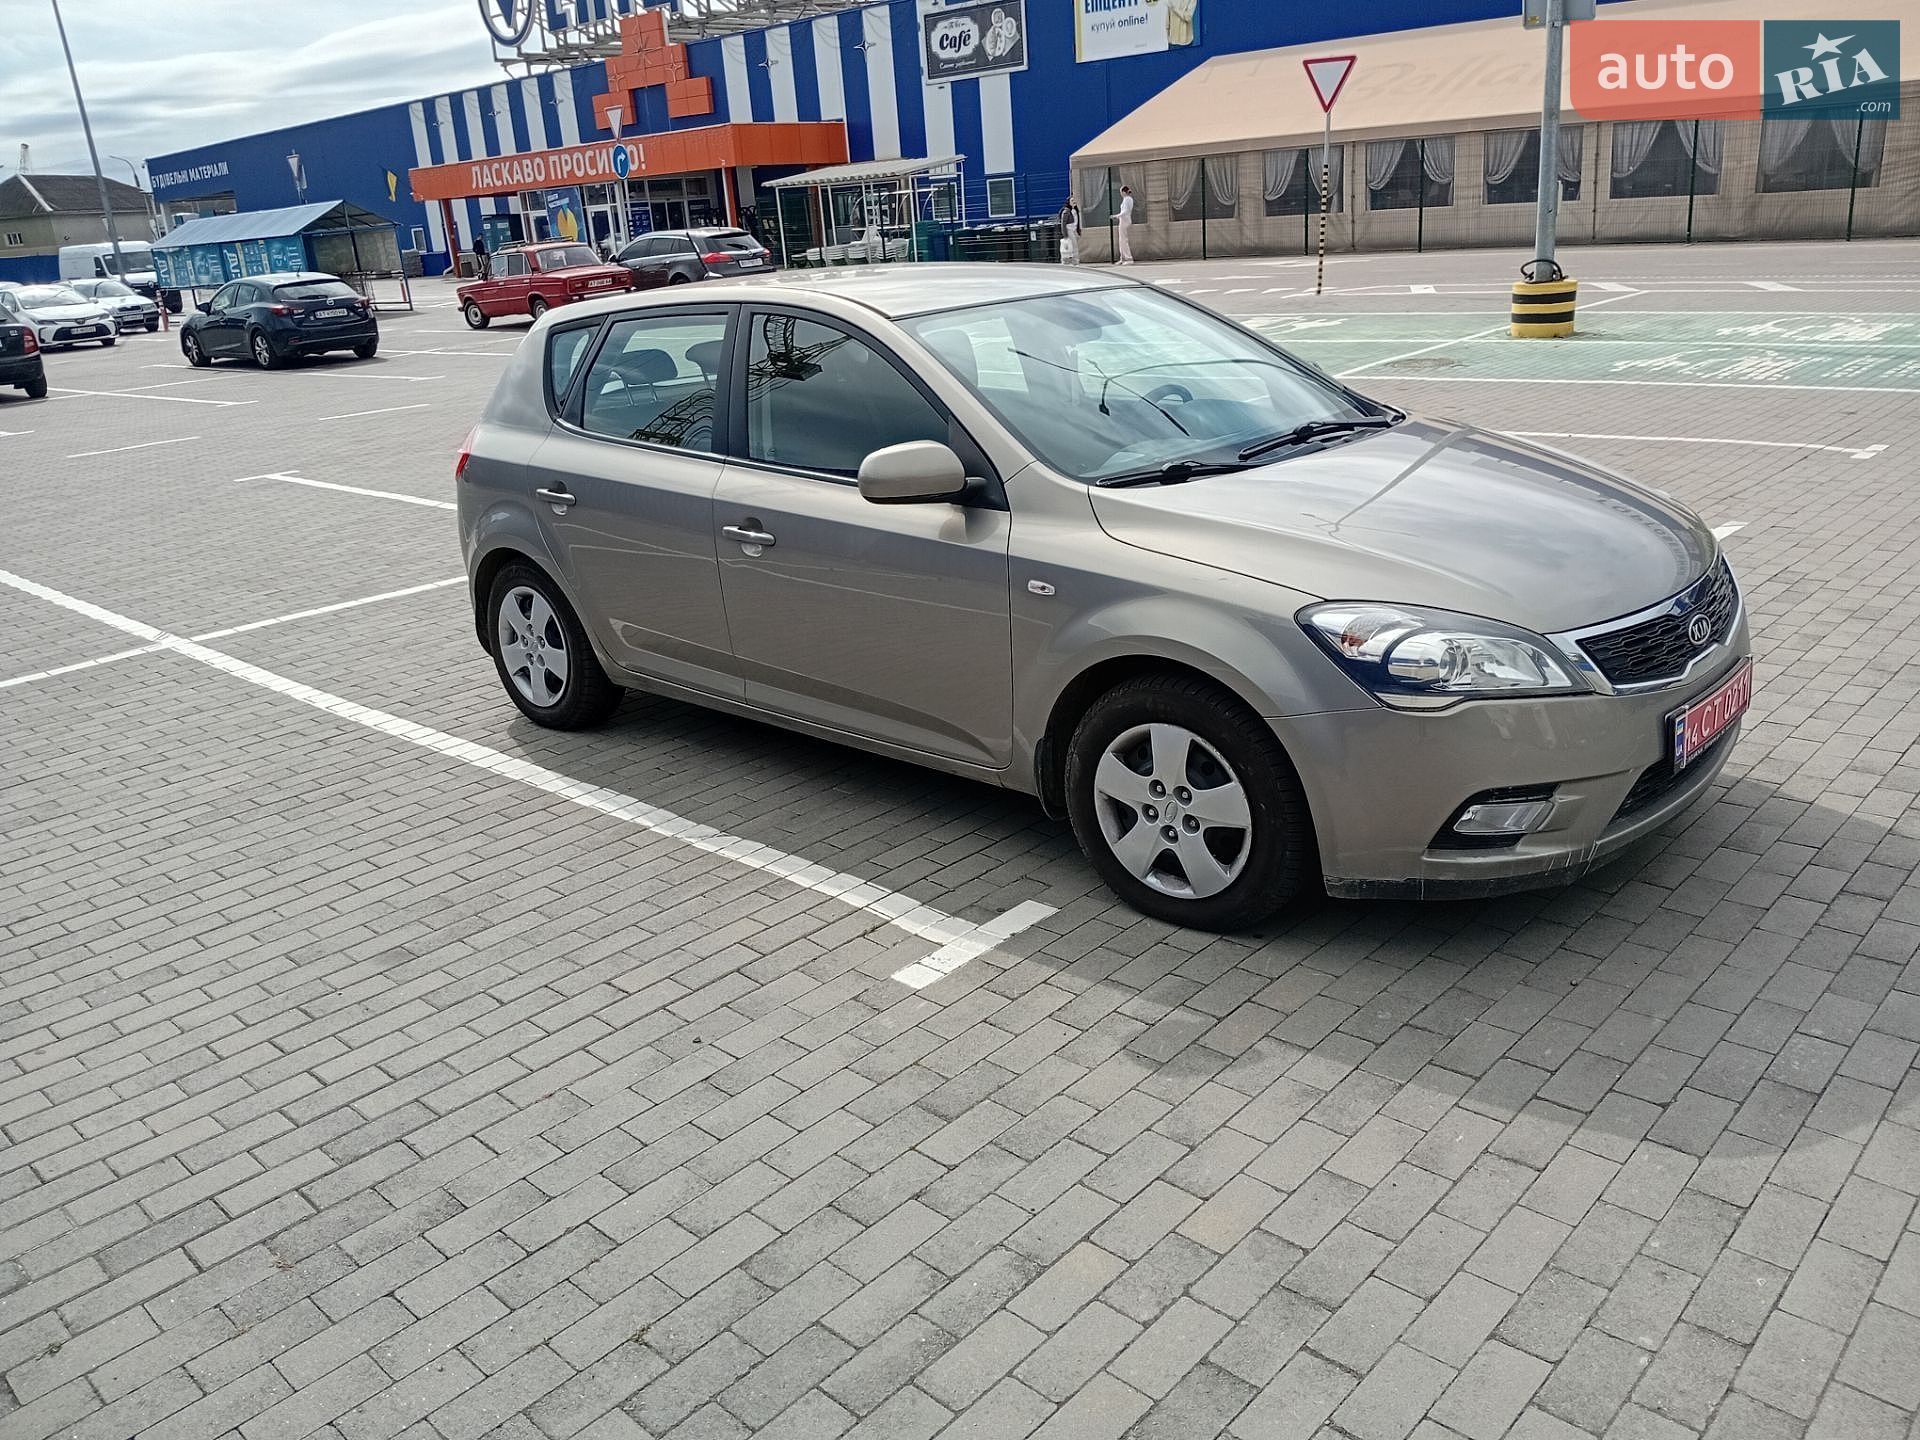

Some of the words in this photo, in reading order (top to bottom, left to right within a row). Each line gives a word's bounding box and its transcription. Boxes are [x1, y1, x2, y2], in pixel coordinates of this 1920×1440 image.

[1091, 18, 1115, 32] купуй
[1118, 12, 1148, 28] online!
[939, 29, 971, 53] Café
[151, 169, 189, 189] БУДІВЕЛЬНІ
[188, 161, 229, 182] МАТЕРІАЛИ
[471, 156, 546, 190] ЛАСКАВО
[1692, 619, 1710, 641] KIA
[1701, 699, 1722, 738] CT
